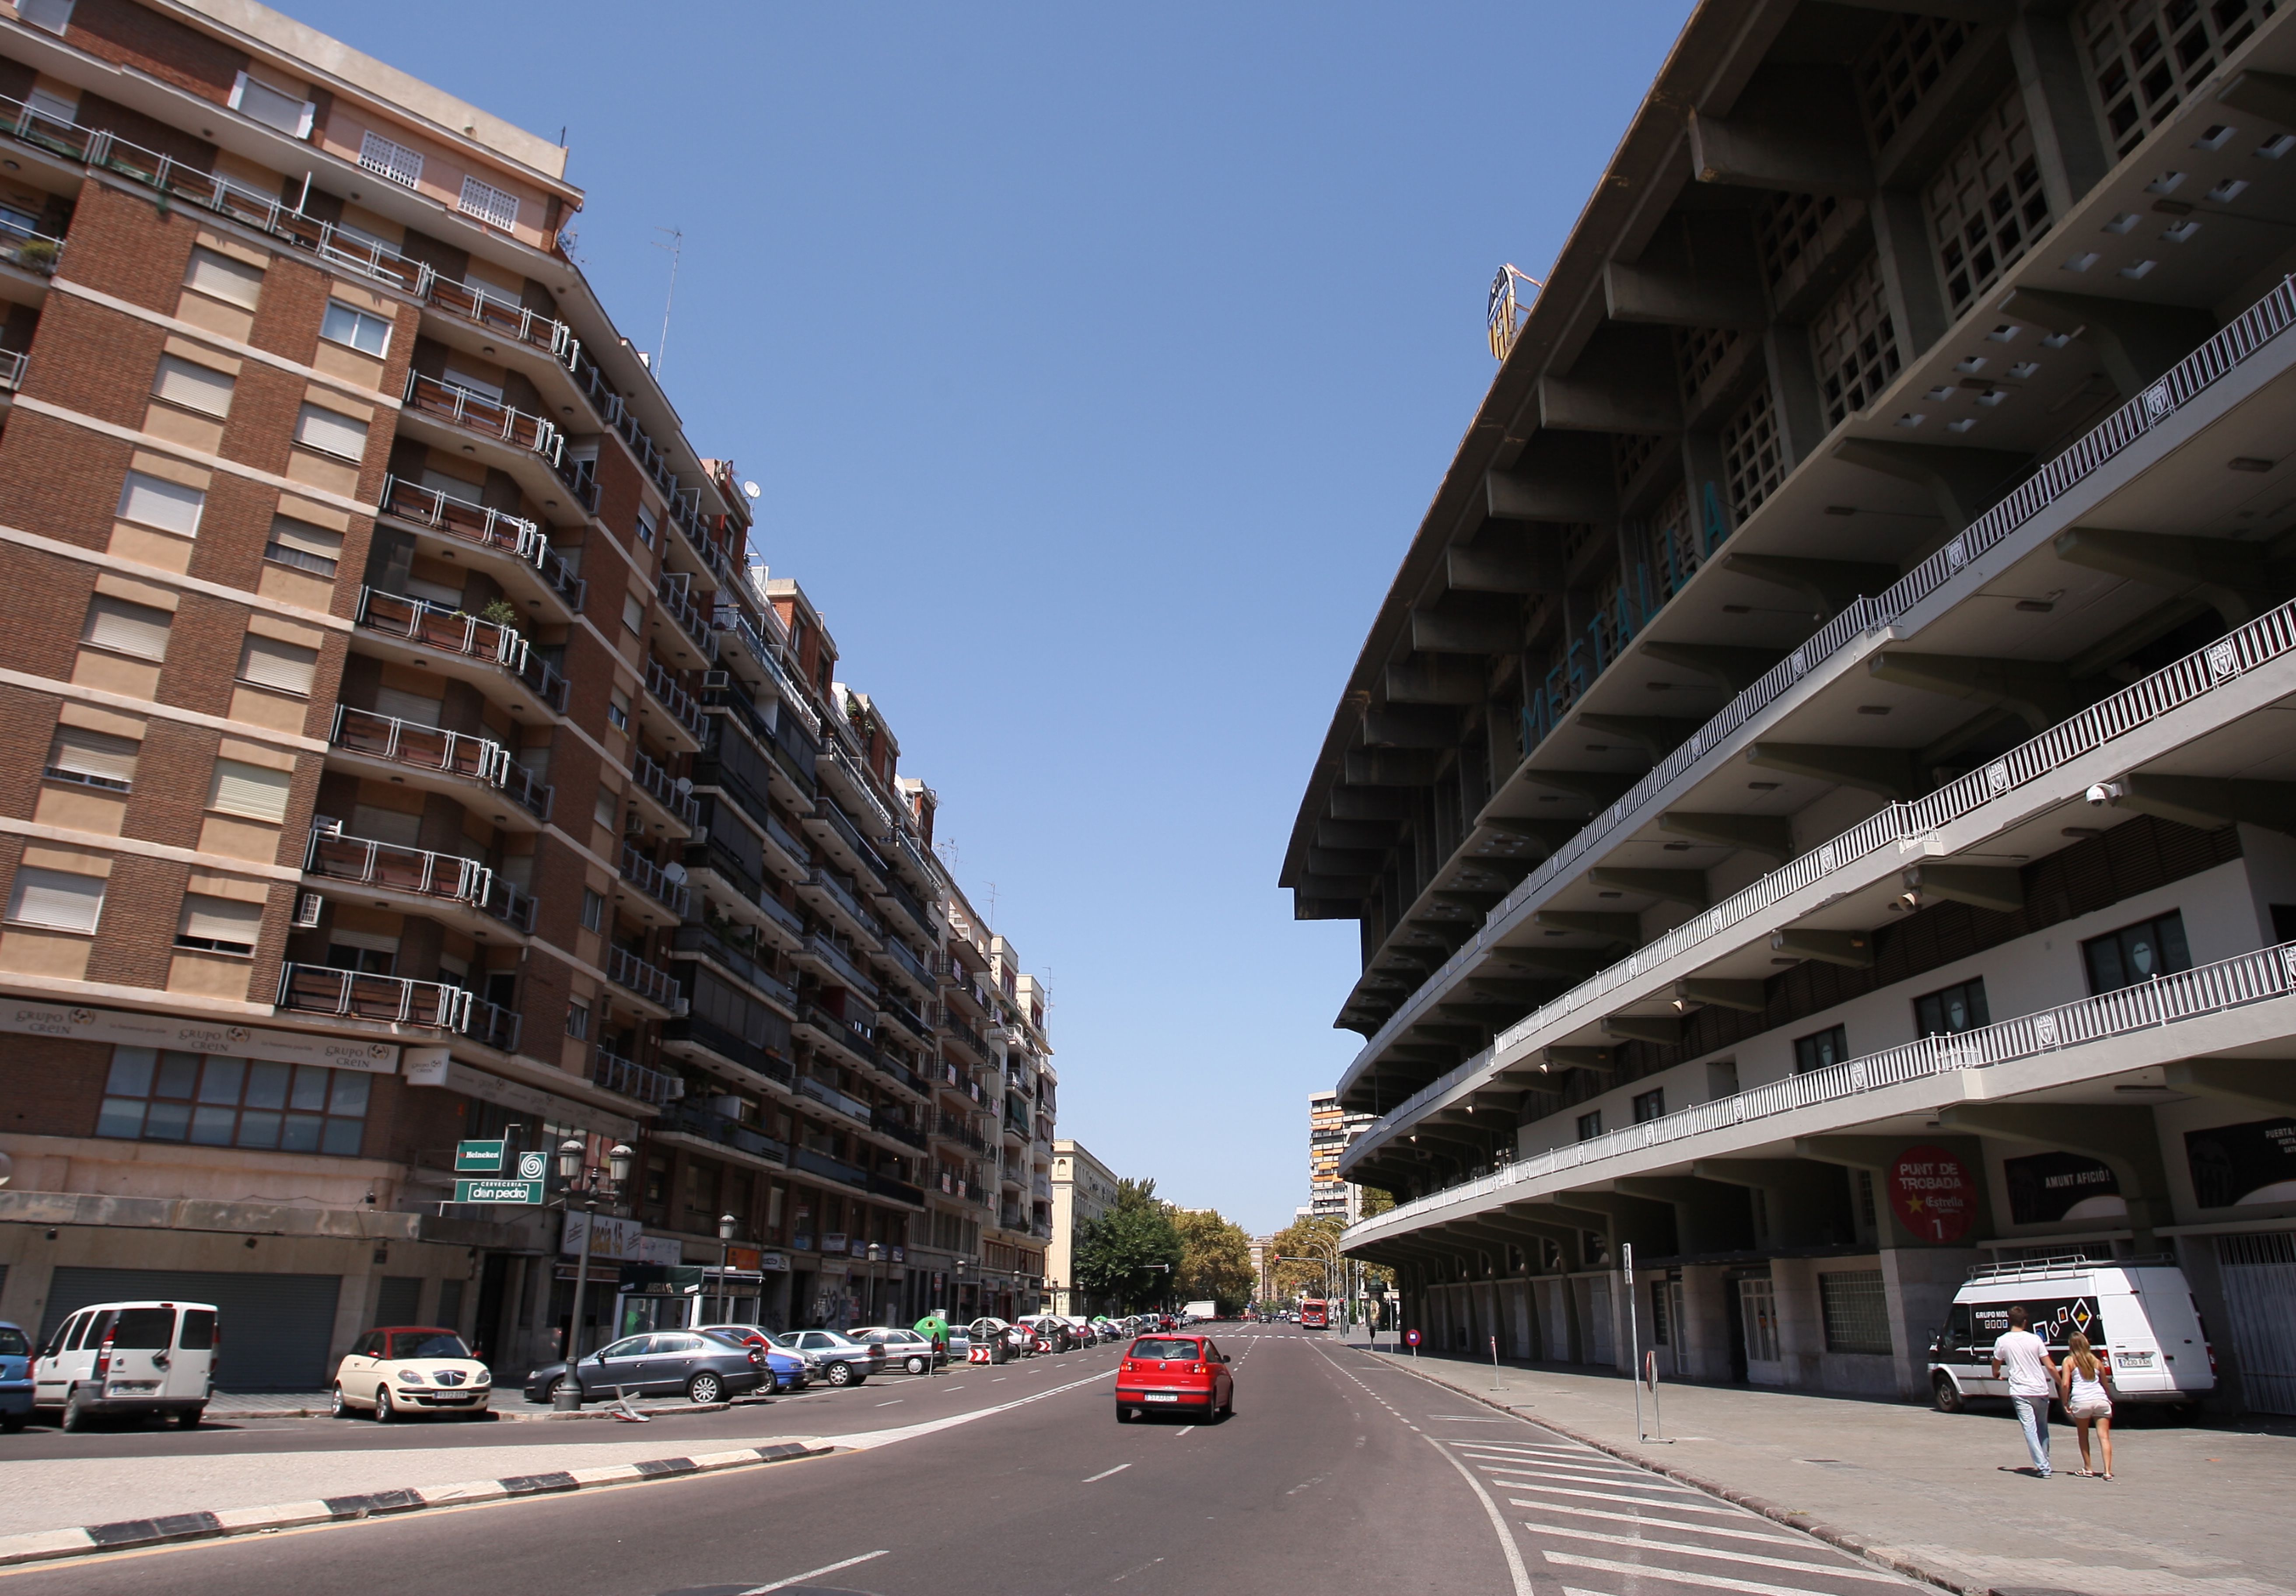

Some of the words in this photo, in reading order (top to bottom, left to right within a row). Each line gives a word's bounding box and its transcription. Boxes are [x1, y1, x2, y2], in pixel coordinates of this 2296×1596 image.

[1522, 481, 1730, 759] MESTALLA
[1900, 1163, 1934, 1175] PUNT
[1939, 1163, 1958, 1175] DE
[1899, 1177, 1963, 1190] TROBADA
[2045, 1174, 2074, 1189] AMUNT
[495, 1187, 527, 1200] pedro
[1926, 1196, 1964, 1208] Estrella
[1932, 1219, 1943, 1239] 1
